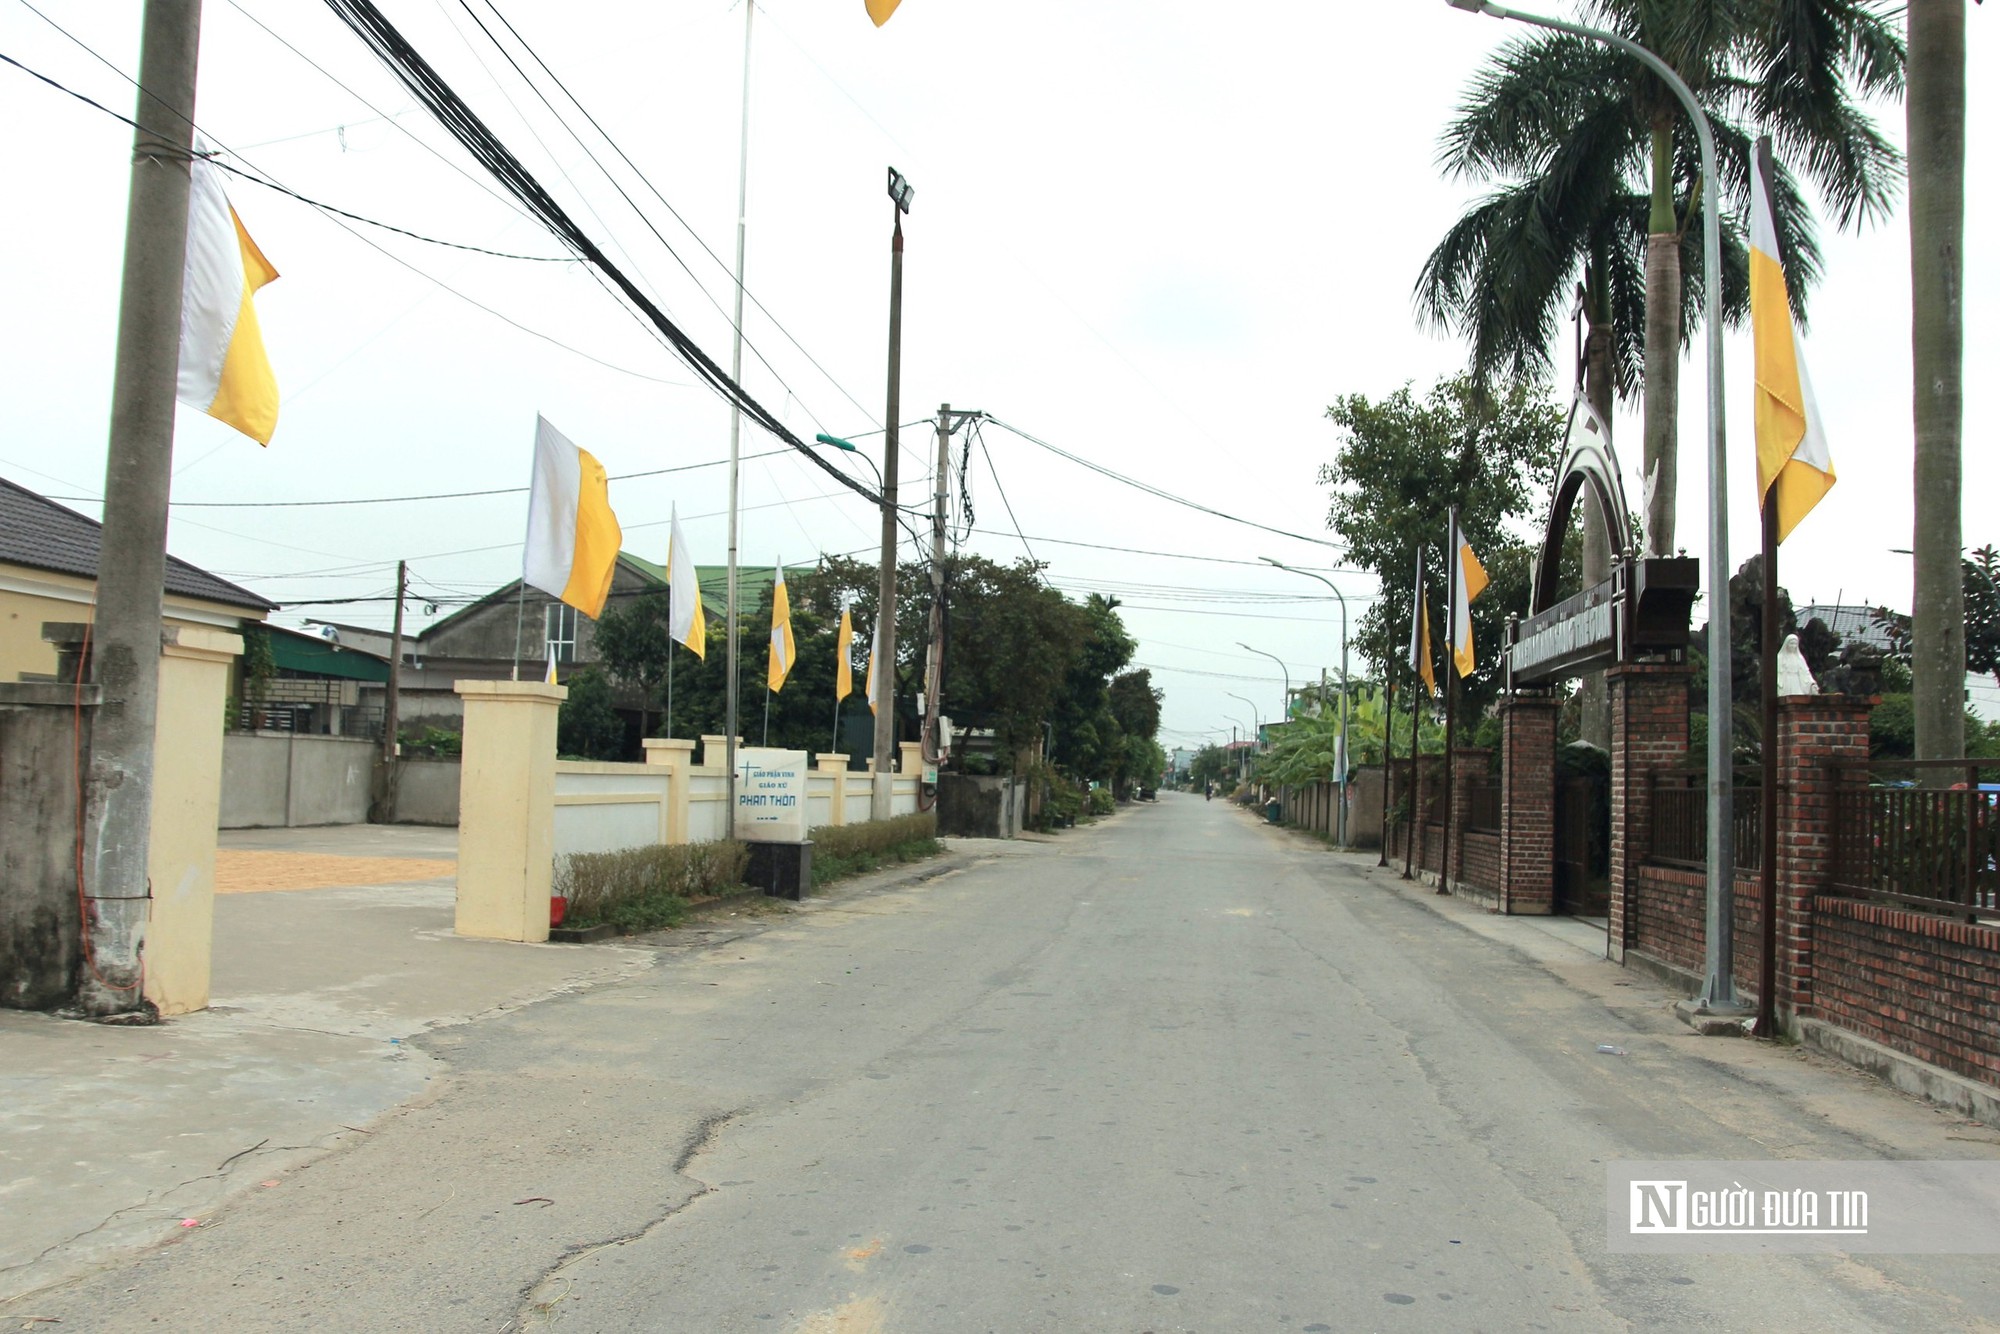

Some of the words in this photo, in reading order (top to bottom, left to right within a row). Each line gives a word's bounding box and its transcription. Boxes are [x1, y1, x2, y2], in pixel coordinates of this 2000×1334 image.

[766, 770, 781, 779] PHẬN
[739, 795, 767, 806] PHAN
[769, 793, 796, 806] THÔN
